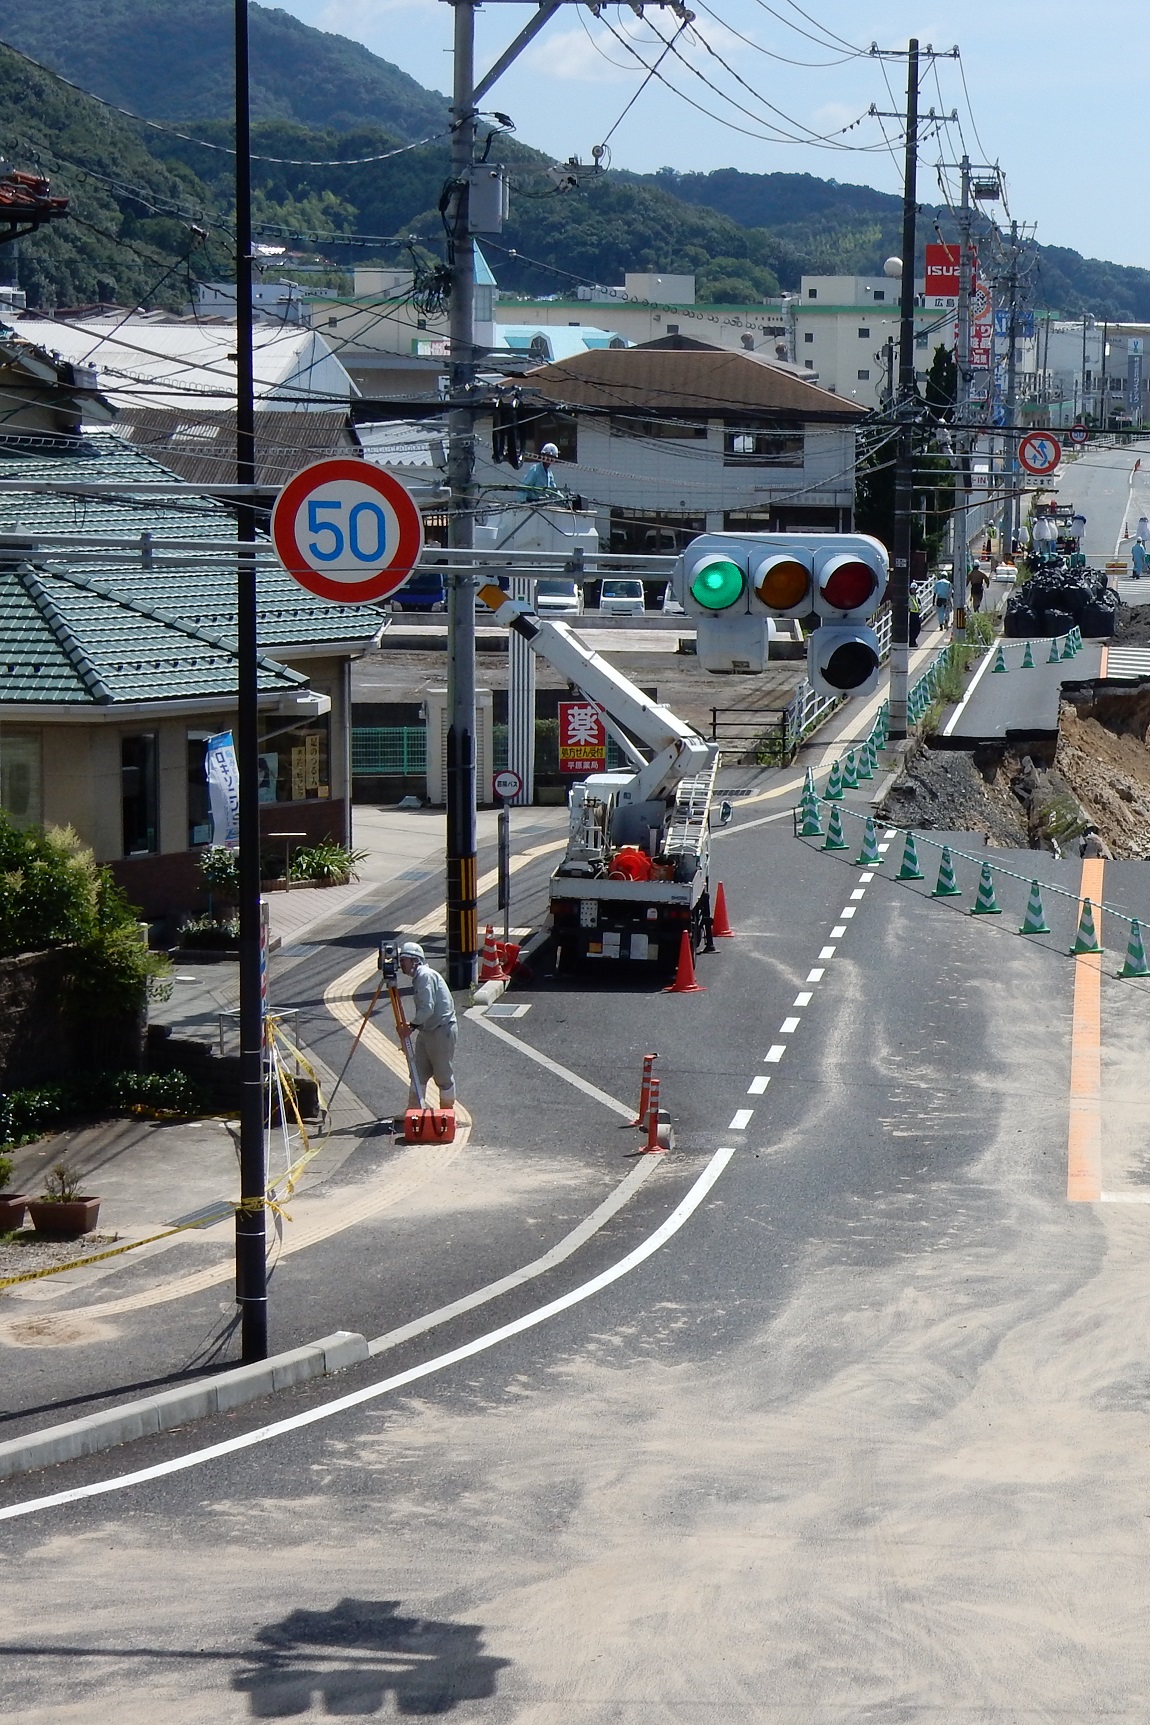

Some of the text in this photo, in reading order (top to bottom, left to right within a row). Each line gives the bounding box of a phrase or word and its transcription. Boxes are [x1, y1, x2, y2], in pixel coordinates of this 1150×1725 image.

[1026, 478, 1052, 486] ここまで
[308, 501, 386, 562] 50
[567, 705, 599, 745] 薬
[561, 747, 604, 758] 処方せん受付
[567, 761, 599, 770] 平原薬局
